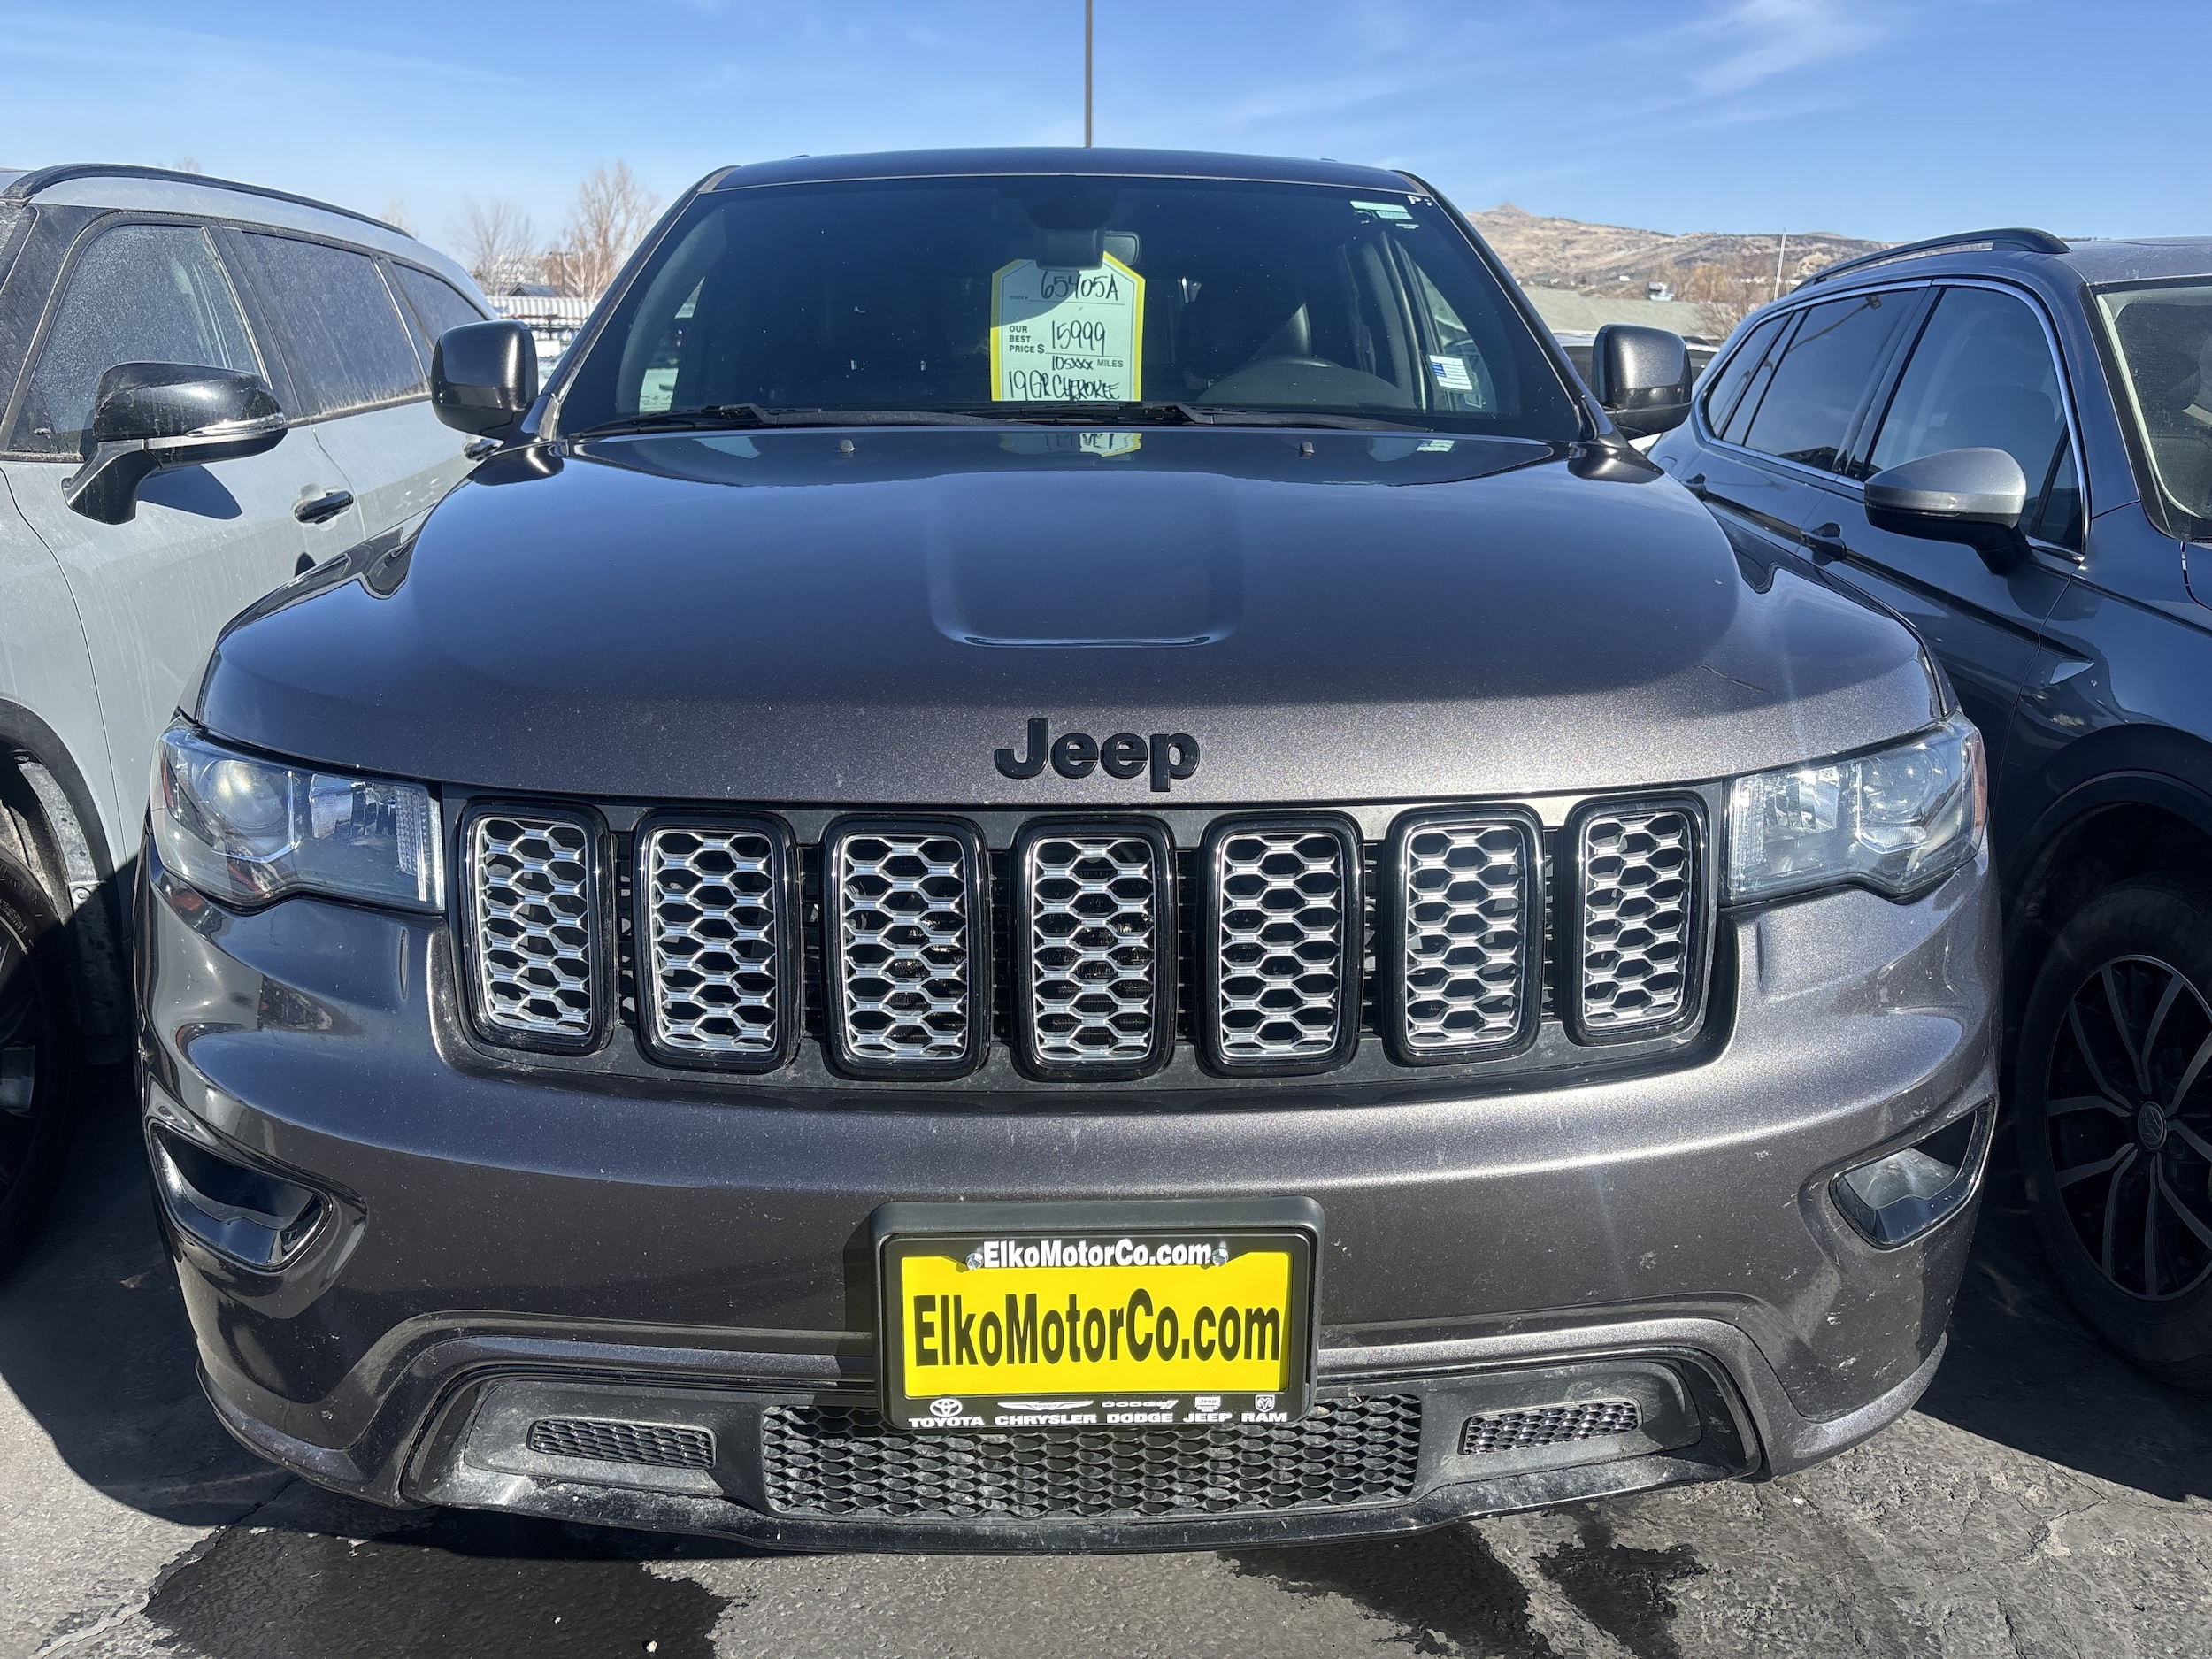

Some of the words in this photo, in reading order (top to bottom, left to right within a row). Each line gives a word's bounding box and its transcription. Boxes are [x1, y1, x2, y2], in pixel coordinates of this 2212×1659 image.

[1041, 270, 1119, 301] 65405A
[1037, 343, 1045, 354] $
[1052, 320, 1105, 357] 15999
[1096, 358, 1124, 368] MILES
[1009, 370, 1028, 401] 19
[994, 718, 1200, 792] Jeep
[983, 1240, 1212, 1269] ElkoMotorCo.com
[913, 1288, 1280, 1367] ElkoMotorCo.com
[908, 1416, 985, 1428] TOYOTA
[995, 1413, 1097, 1425] CHRYSLER
[1107, 1412, 1173, 1424] DODGE
[1183, 1412, 1233, 1423] JEEP
[1241, 1412, 1287, 1423] RAM
